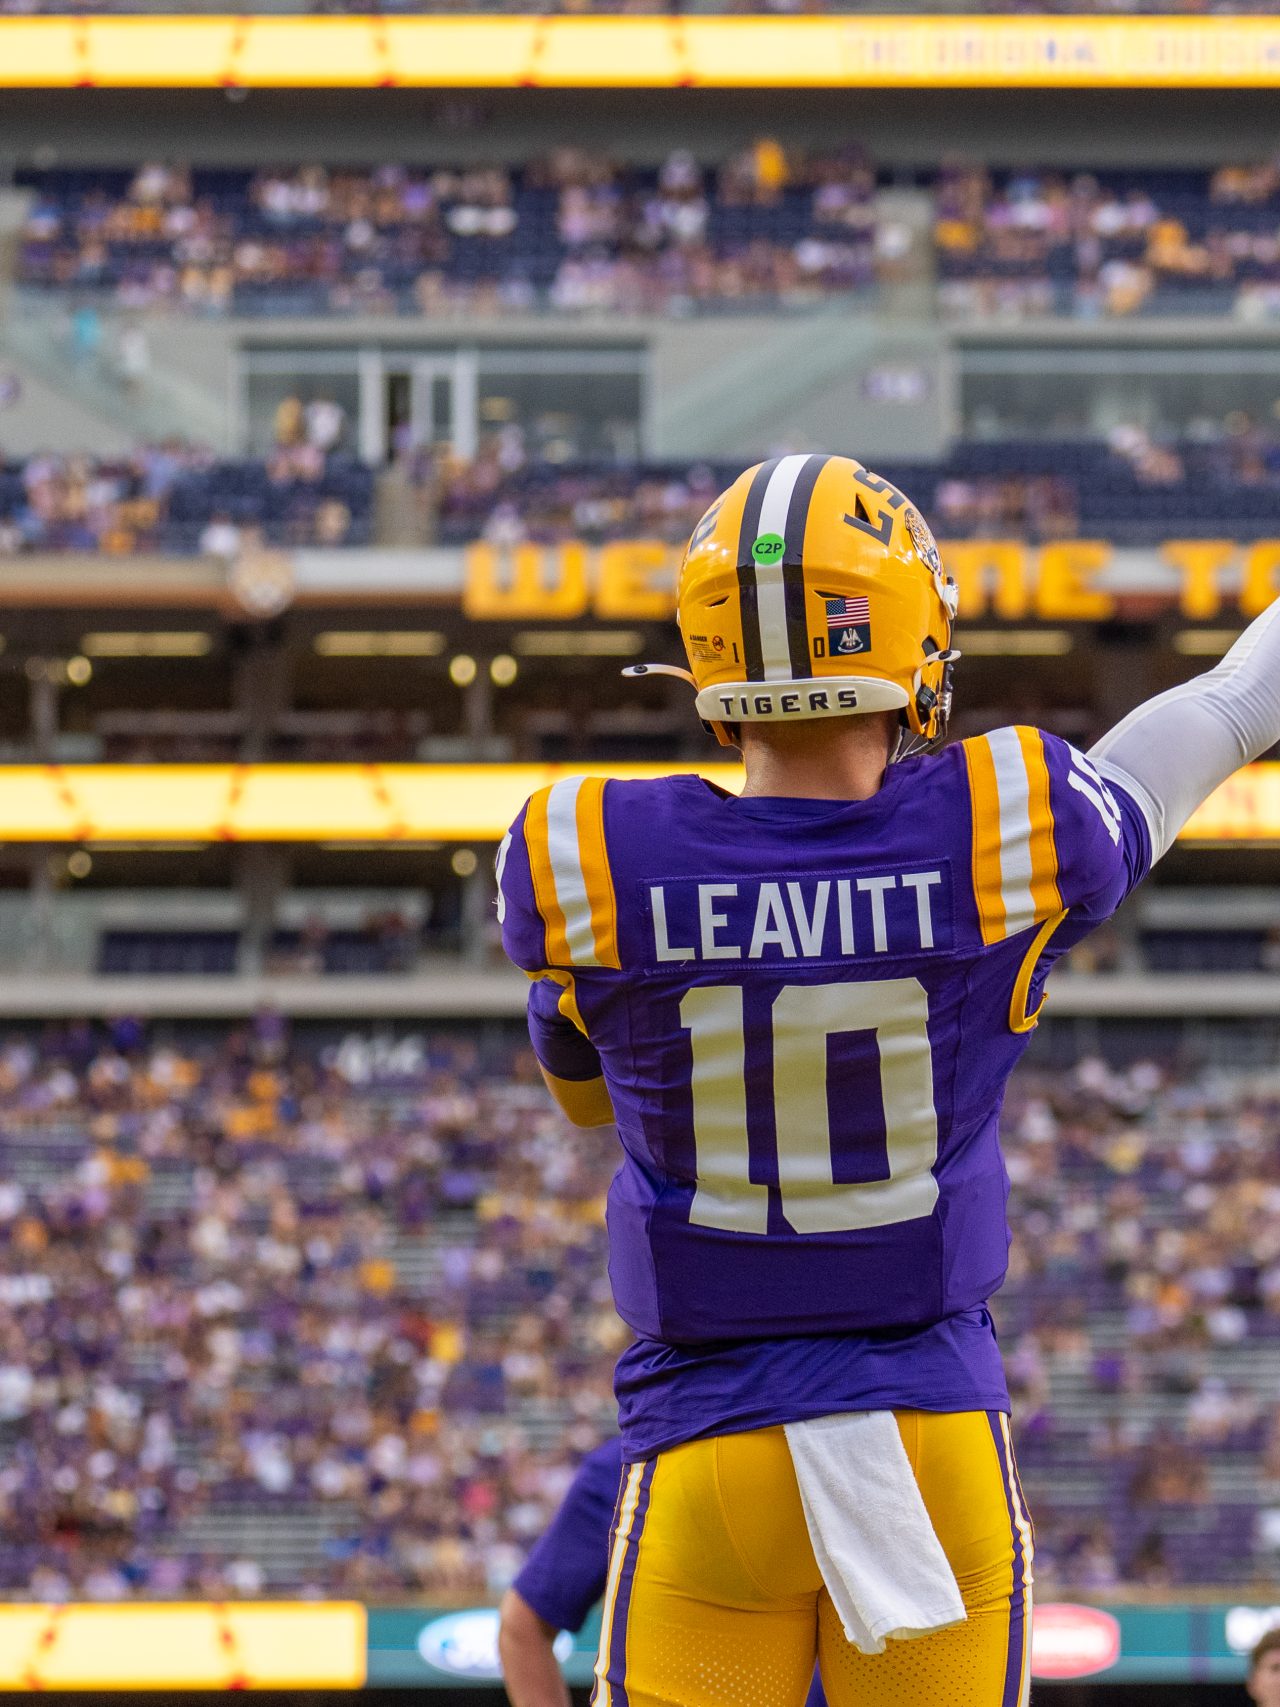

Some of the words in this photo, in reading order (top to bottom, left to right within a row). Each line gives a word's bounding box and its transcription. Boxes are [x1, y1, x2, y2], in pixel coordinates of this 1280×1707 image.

[755, 543, 783, 555] C2P
[720, 690, 857, 715] TIGERS
[650, 871, 942, 962] LEAVITT
[679, 977, 940, 1235] 10
